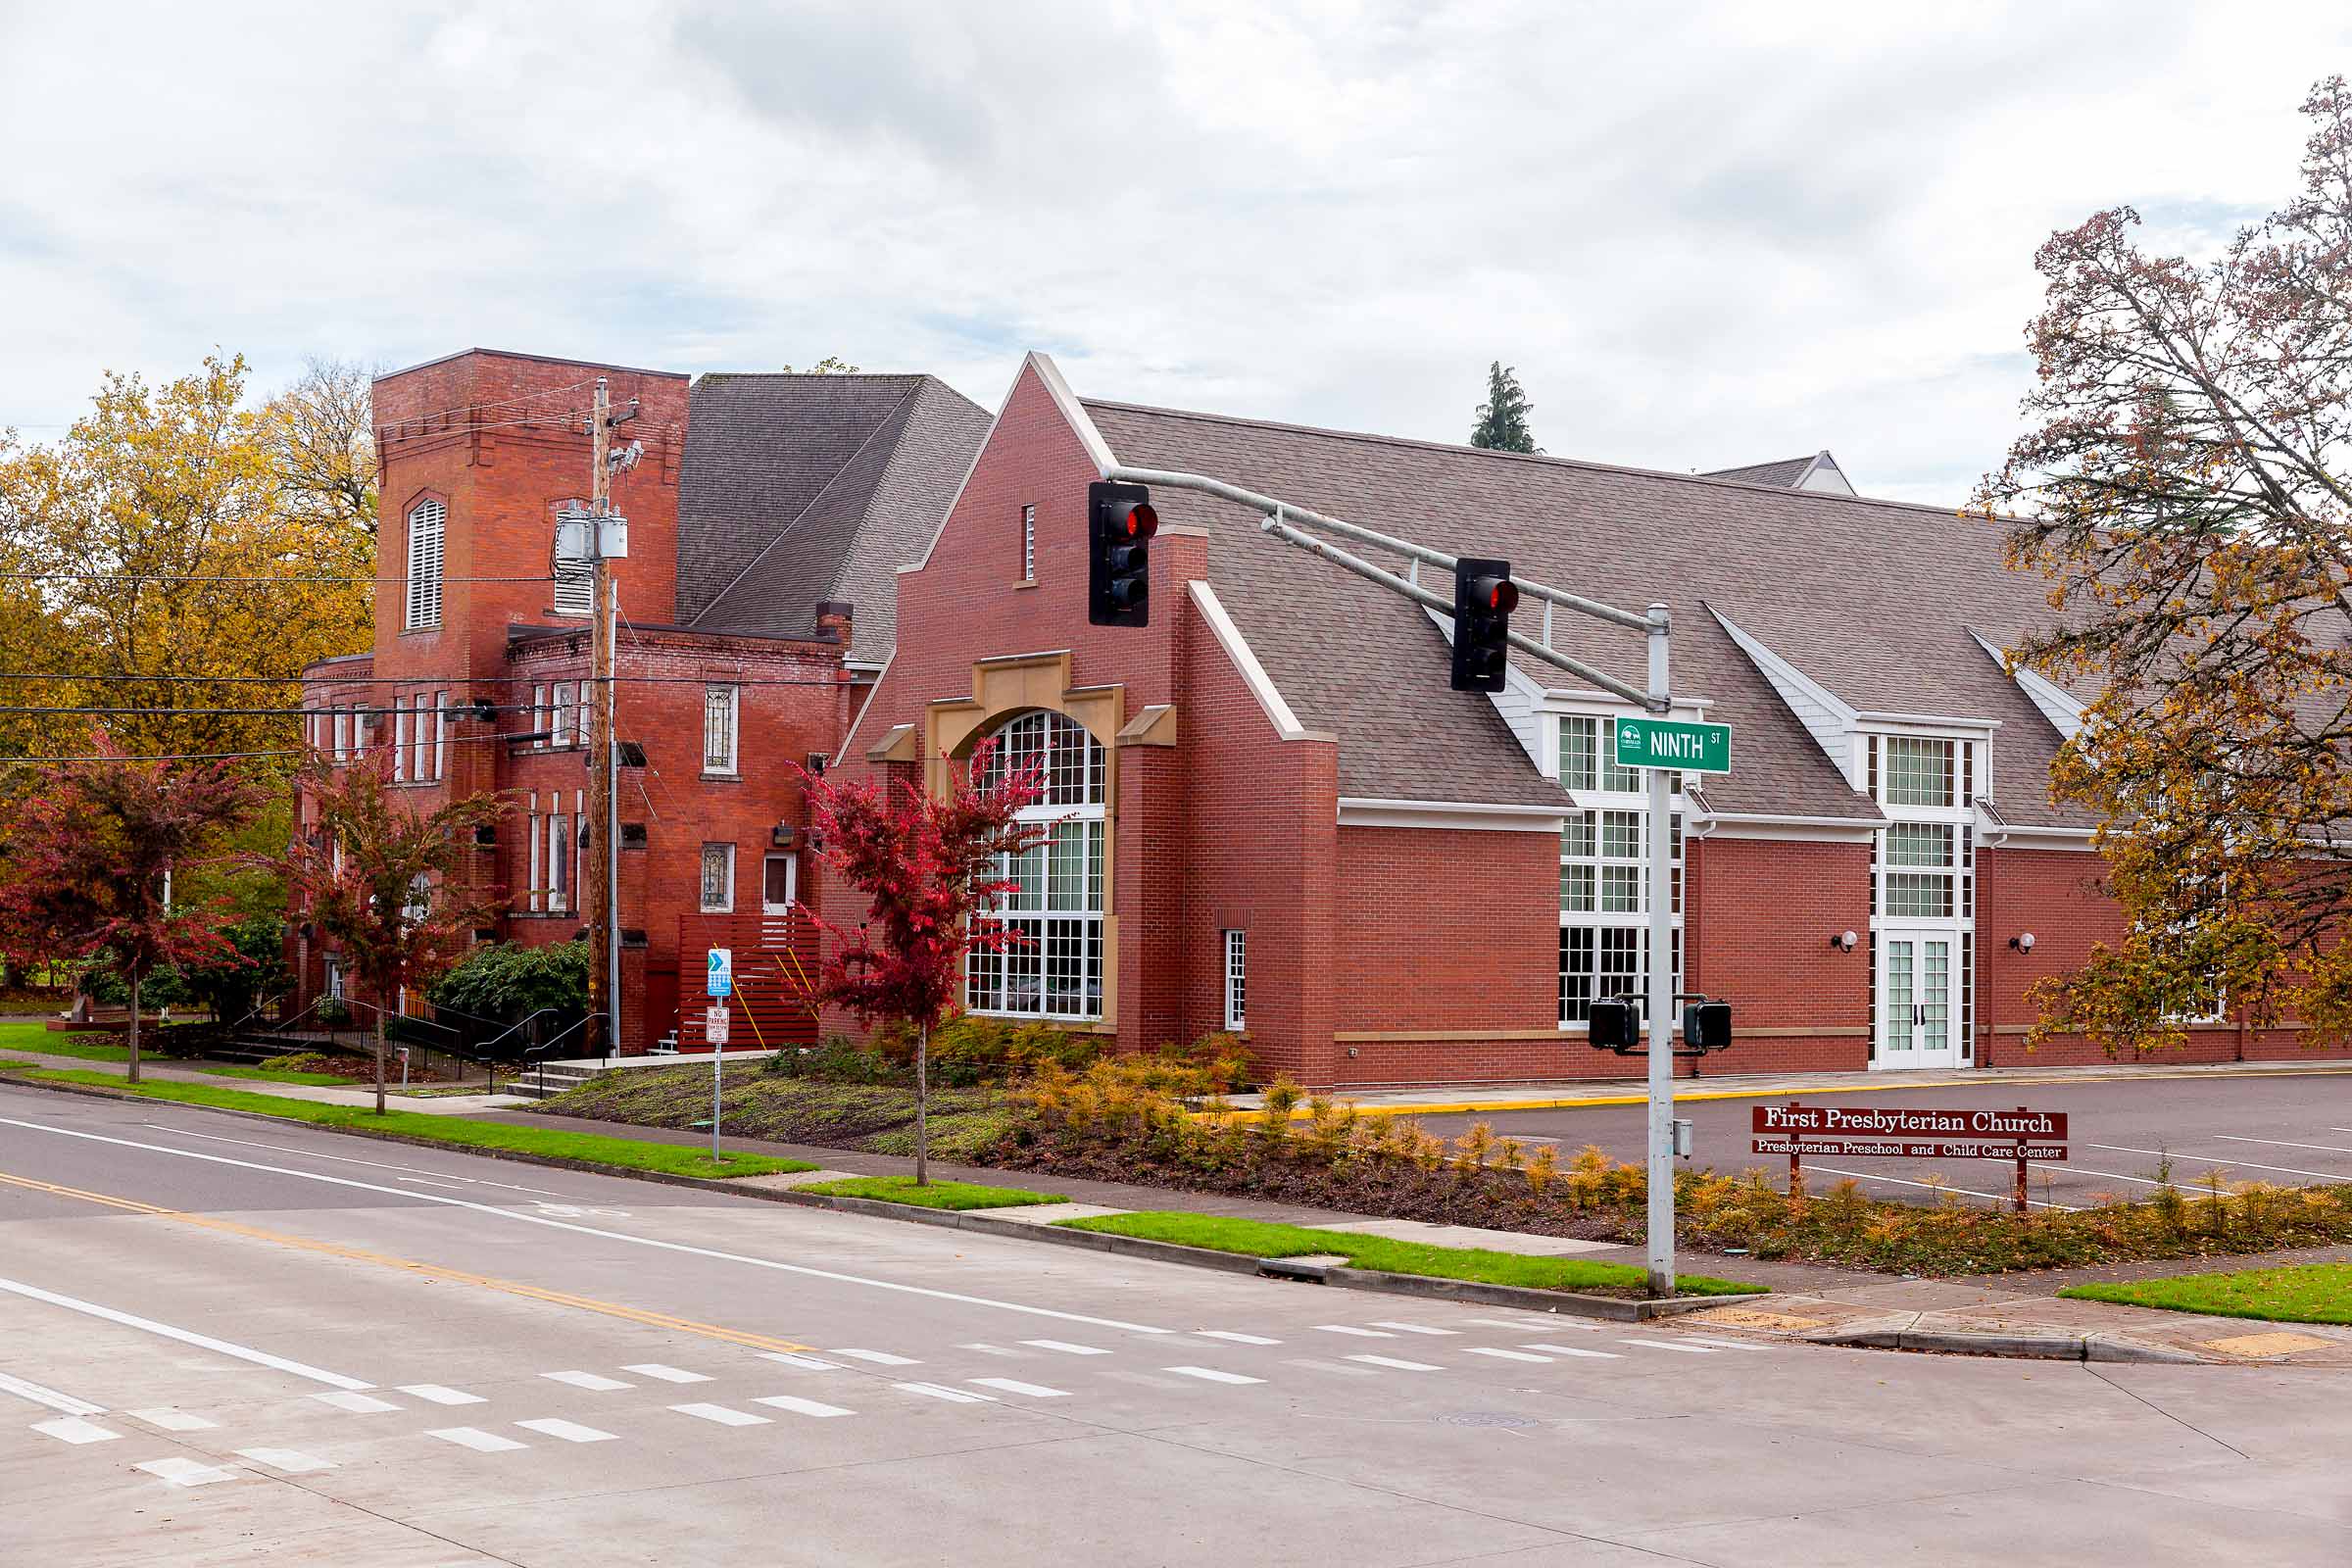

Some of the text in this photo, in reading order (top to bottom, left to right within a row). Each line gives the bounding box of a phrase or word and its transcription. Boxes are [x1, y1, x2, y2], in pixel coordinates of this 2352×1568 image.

[1650, 731, 1721, 760] NINTH ST
[1764, 1107, 2055, 1134] First Presbyterian Church
[1757, 1140, 2062, 1158] Presbyterian Preschool and Child Care Center
